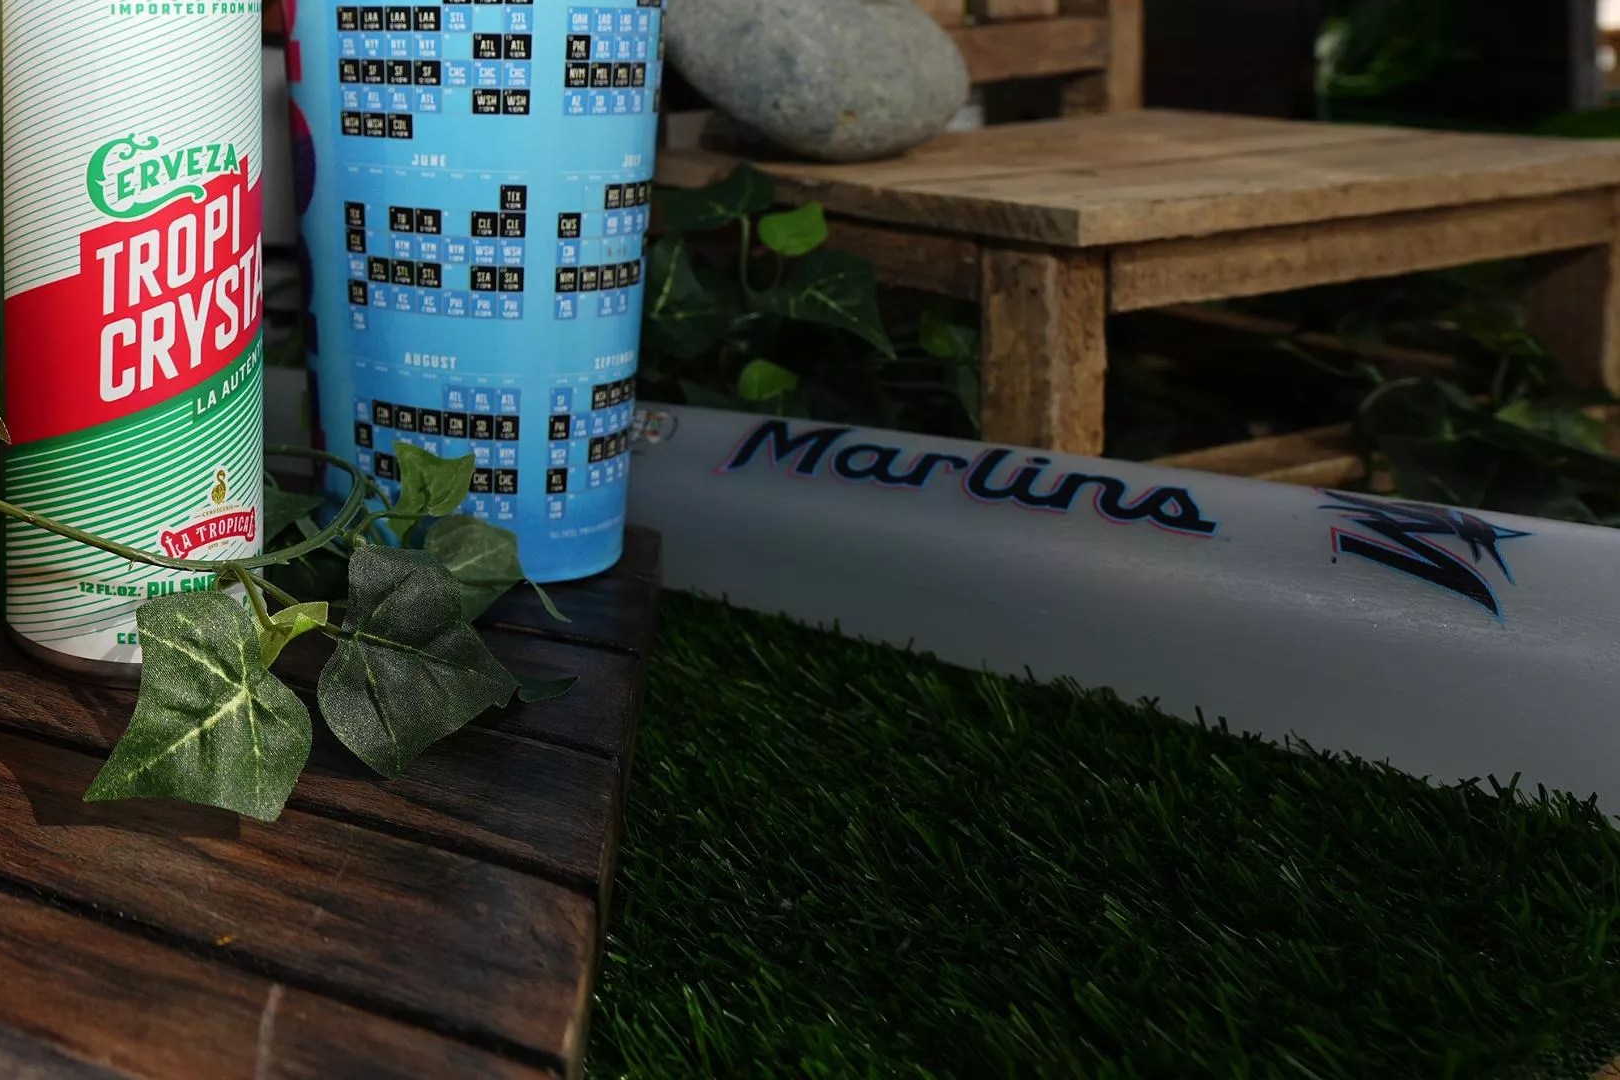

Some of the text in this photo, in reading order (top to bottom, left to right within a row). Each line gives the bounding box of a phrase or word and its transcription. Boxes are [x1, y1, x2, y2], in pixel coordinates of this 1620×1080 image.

[111, 2, 206, 15] IMPORTED
[212, 1, 245, 14] FROM
[412, 153, 447, 167] JUNE
[87, 133, 240, 219] CERVEZA
[96, 184, 241, 316] TROPI
[404, 352, 457, 369] AUGUST
[197, 390, 217, 415] LA
[716, 419, 1220, 538] Marlins
[165, 508, 256, 558] LA TROPICAL
[79, 582, 95, 593] 12
